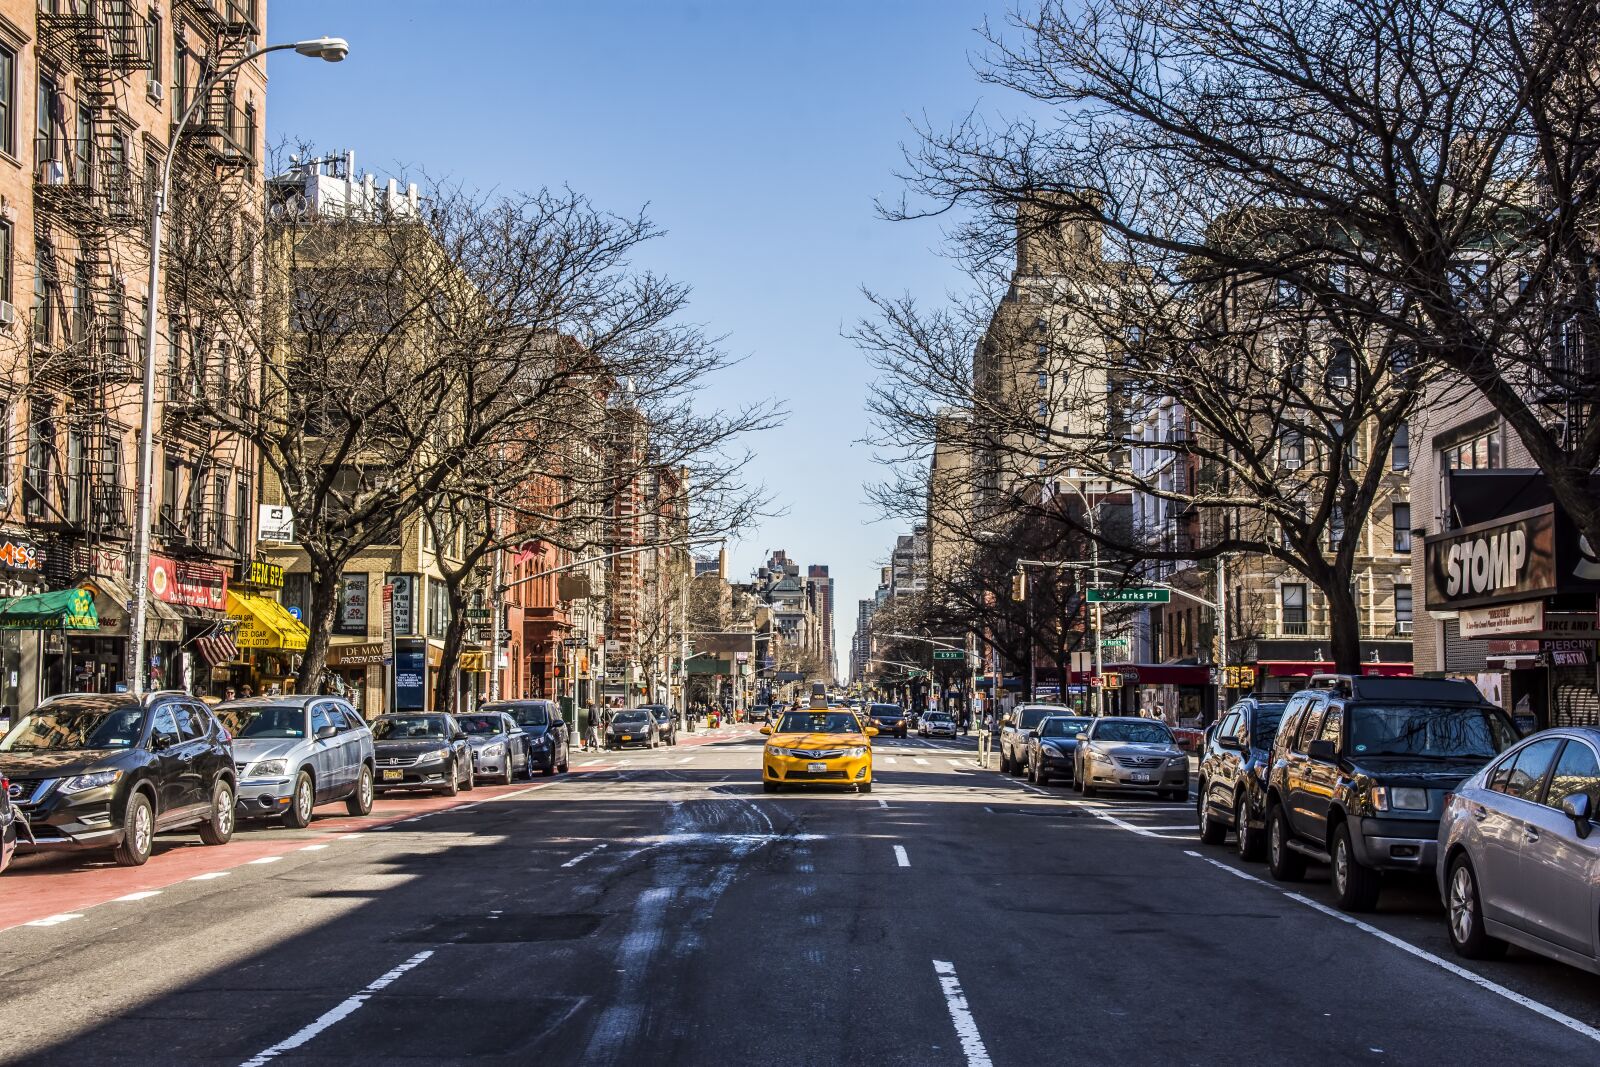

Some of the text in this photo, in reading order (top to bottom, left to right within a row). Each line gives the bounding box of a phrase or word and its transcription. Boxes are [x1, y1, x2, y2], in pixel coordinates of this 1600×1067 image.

[1446, 529, 1526, 597] STOMP
[252, 562, 284, 587] GEM SPA
[1147, 592, 1157, 600] Pl
[1571, 620, 1589, 631] AND
[250, 630, 267, 638] CIGAR
[236, 638, 269, 646] ANDY LOTTO
[340, 657, 367, 665] FROZEN
[1566, 652, 1586, 665] ATM
